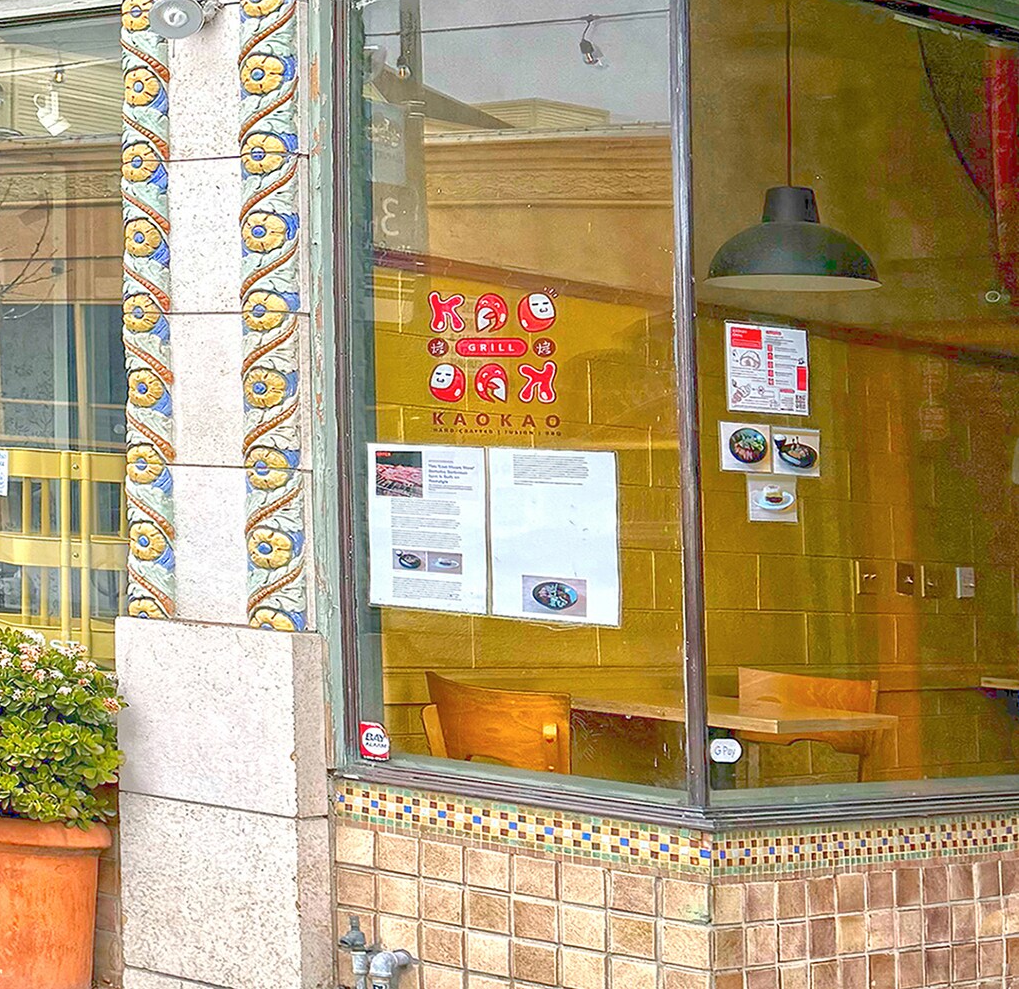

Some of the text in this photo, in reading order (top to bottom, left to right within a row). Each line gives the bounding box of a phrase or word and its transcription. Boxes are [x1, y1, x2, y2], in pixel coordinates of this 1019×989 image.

[467, 343, 515, 352] GRILL
[432, 412, 561, 428] KAOKAO
[365, 732, 384, 742] BAY
[722, 745, 736, 758] Pay
